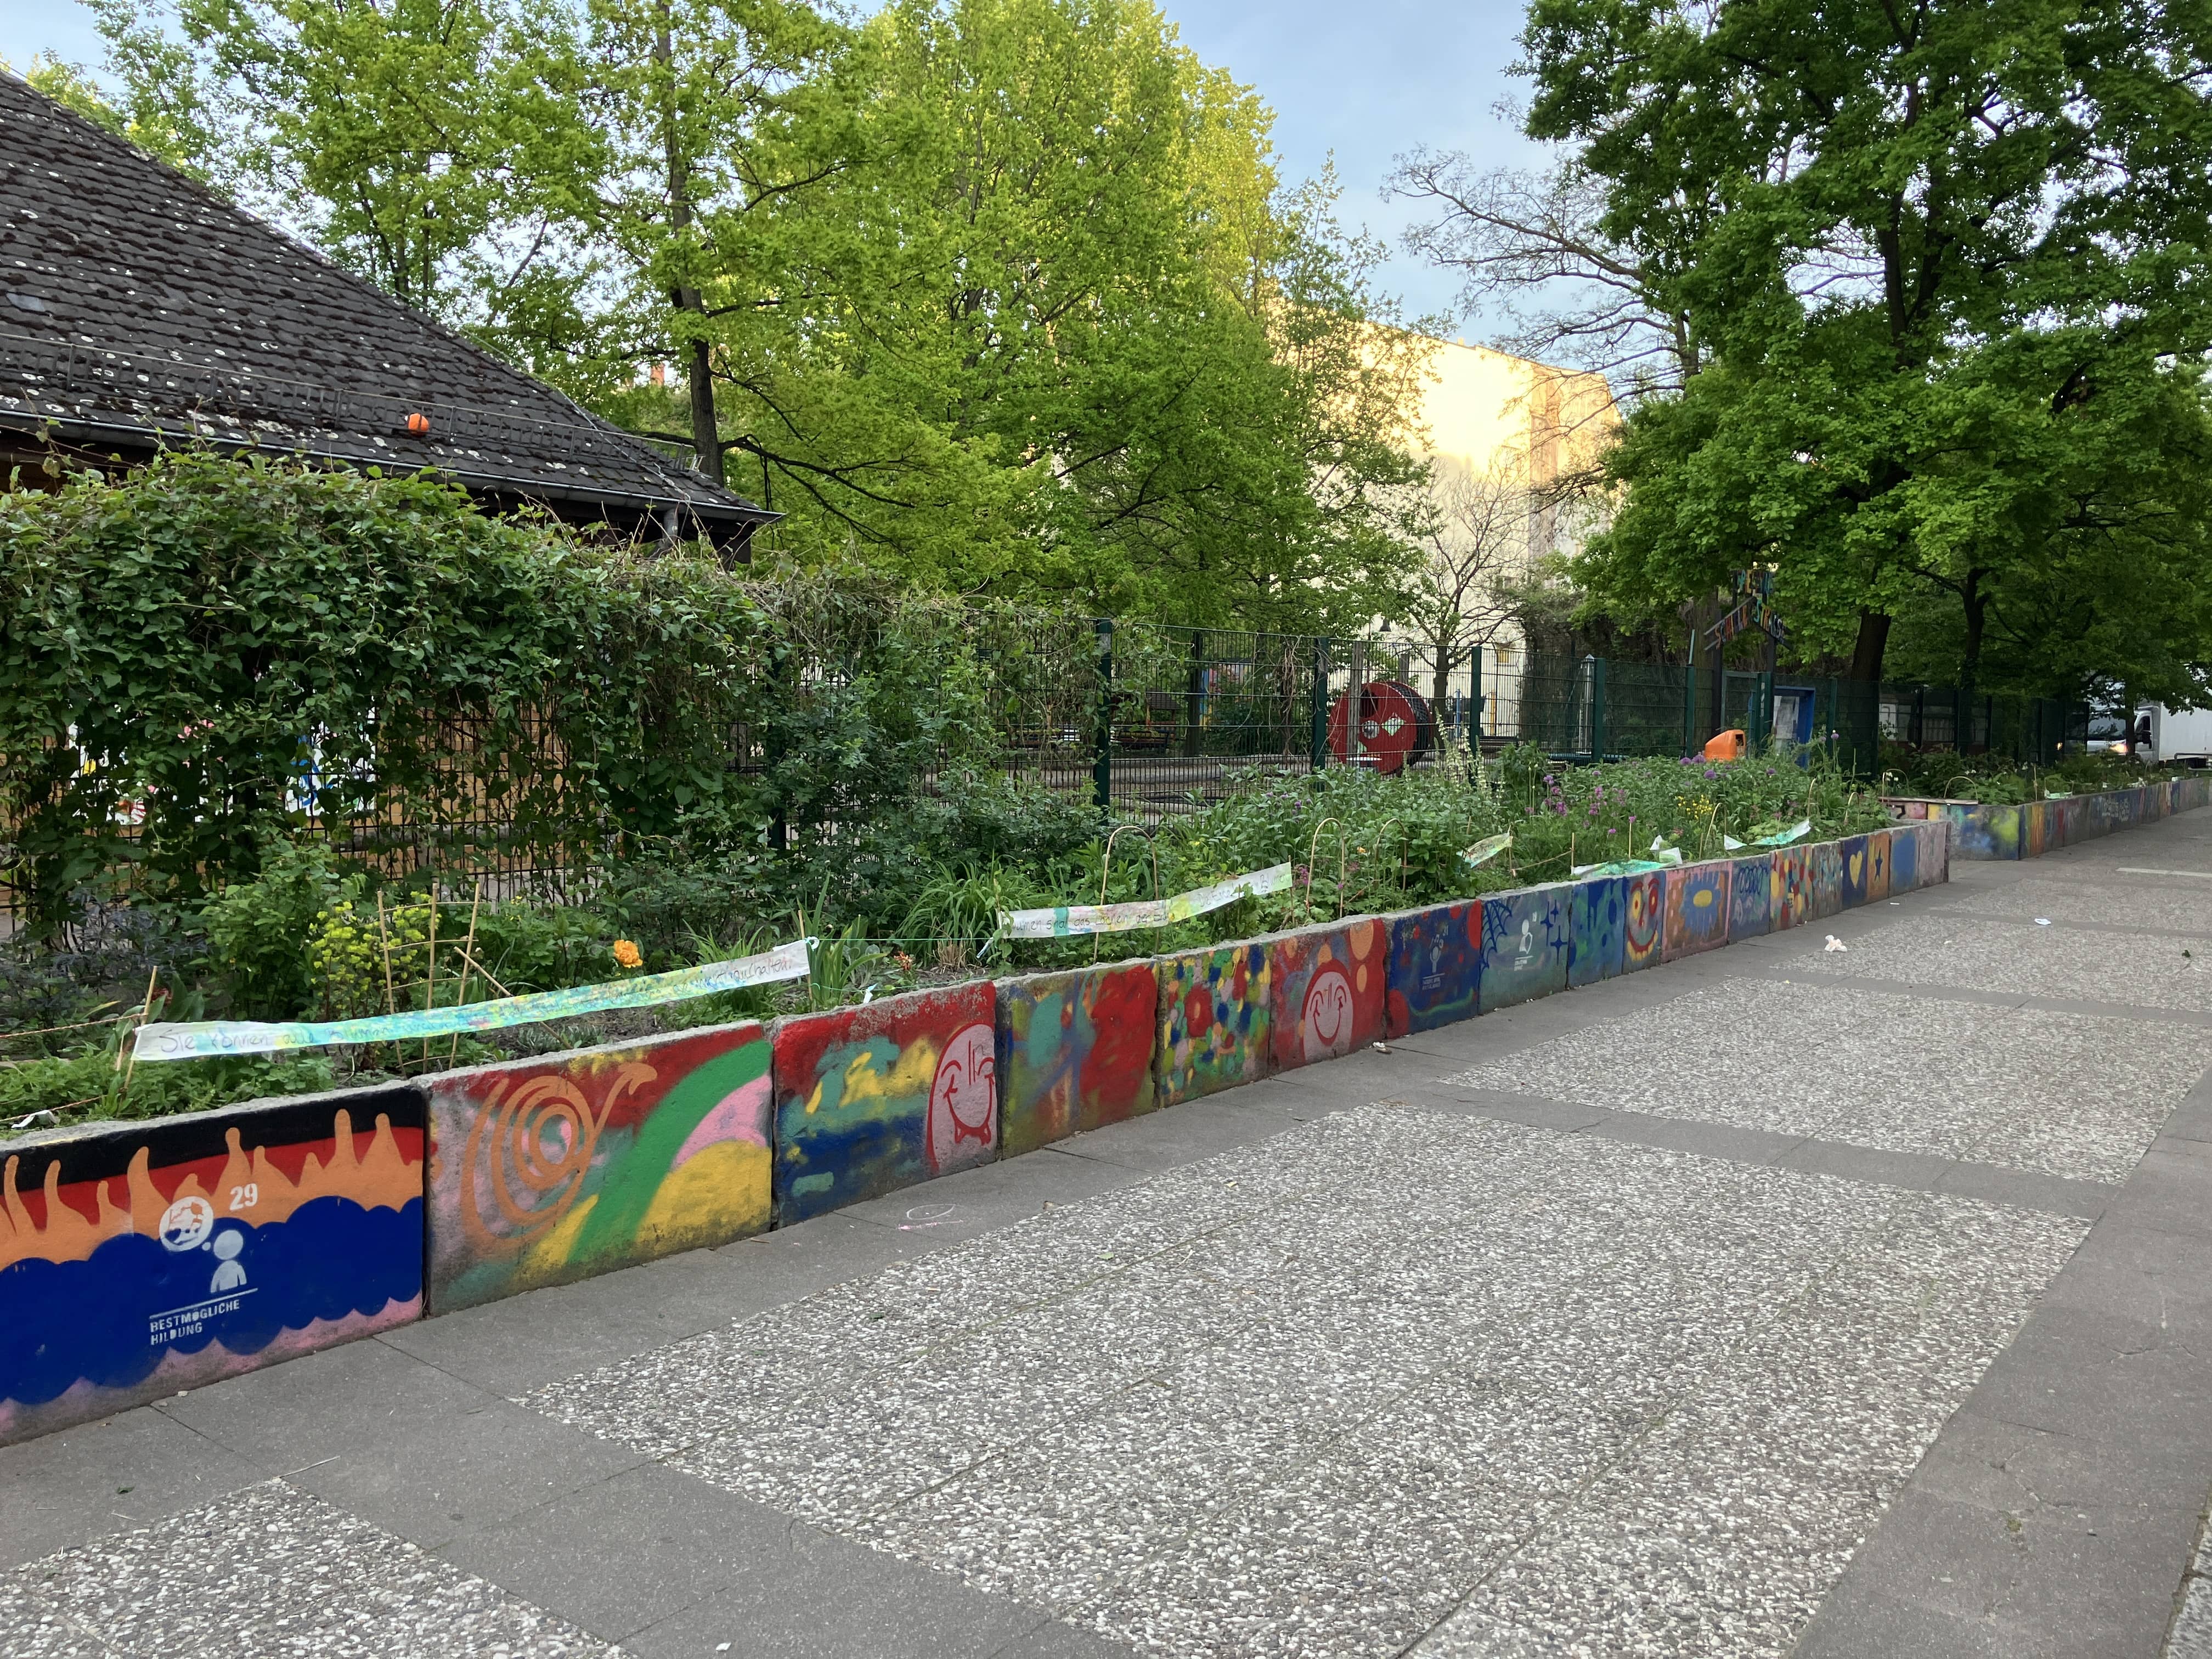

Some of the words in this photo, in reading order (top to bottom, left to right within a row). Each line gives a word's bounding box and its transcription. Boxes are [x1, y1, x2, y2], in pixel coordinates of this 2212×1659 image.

[1074, 915, 1090, 926] das
[159, 1029, 195, 1053] Sie
[229, 1183, 258, 1211] 29
[150, 1299, 240, 1333] BESTMÖGLICHE
